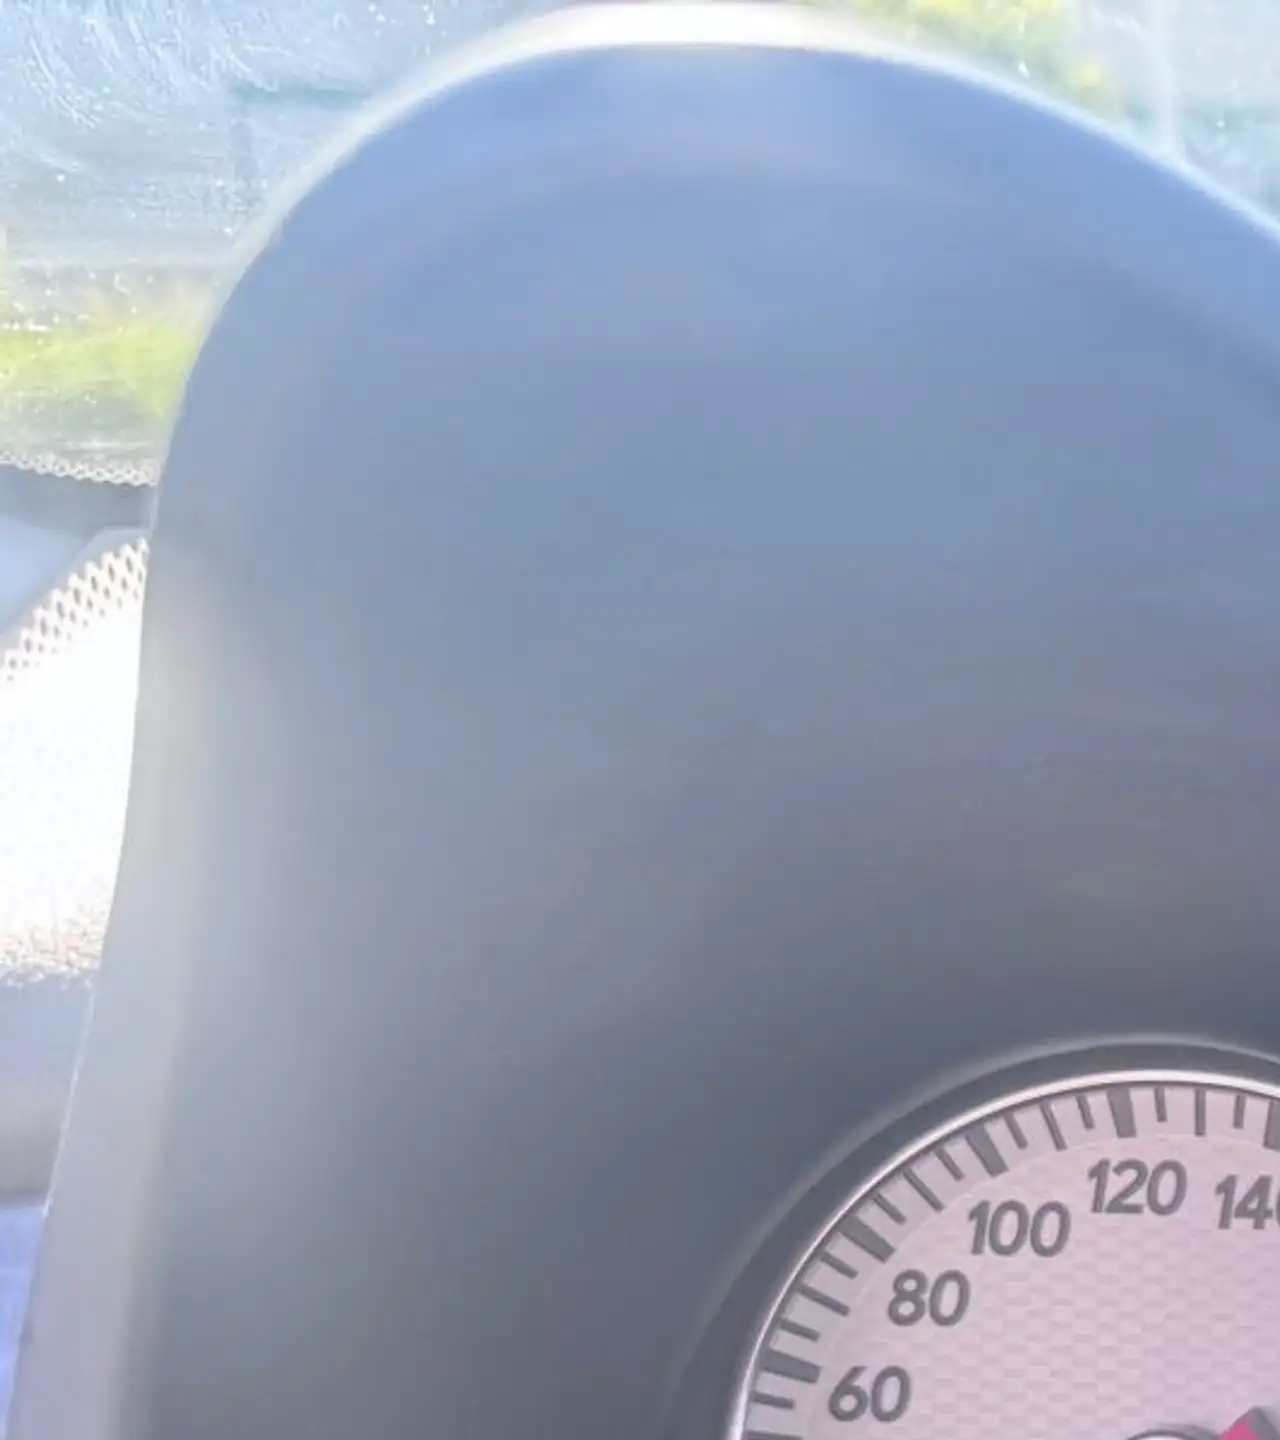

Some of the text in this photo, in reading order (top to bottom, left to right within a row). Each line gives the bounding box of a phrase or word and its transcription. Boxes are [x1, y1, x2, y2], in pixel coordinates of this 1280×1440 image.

[1086, 1158, 1188, 1217] 120
[966, 1198, 1071, 1258] 100
[885, 1269, 971, 1327] 80
[826, 1364, 912, 1423] 60
